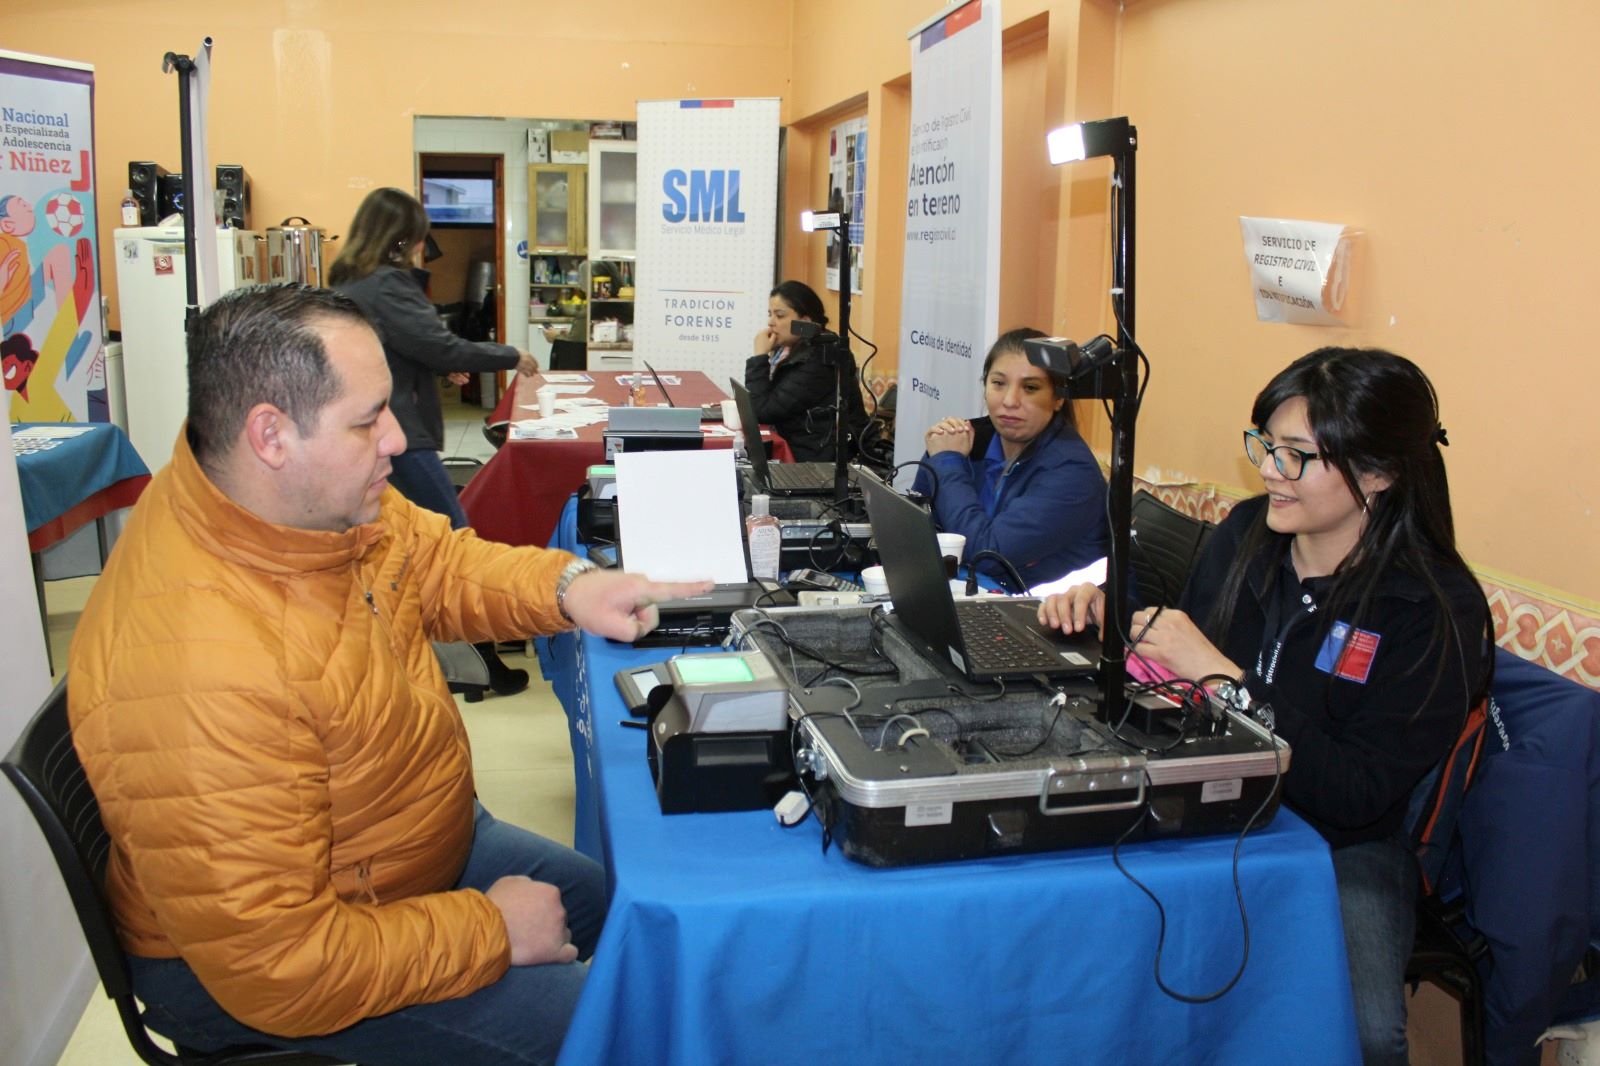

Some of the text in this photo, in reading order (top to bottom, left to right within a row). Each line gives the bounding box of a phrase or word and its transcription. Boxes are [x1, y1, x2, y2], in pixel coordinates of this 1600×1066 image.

[2, 107, 69, 127] Nacional
[5, 124, 70, 138] Especializada
[2, 137, 72, 151] Adolescencia
[9, 150, 72, 174] Niñez
[662, 168, 746, 223] SML
[908, 198, 919, 217] en
[660, 223, 692, 235] Servicio
[724, 224, 746, 237] Legal
[1261, 235, 1316, 251] SERVICIO DE
[1254, 253, 1316, 272] REGISTRO CIVIL
[1278, 275, 1283, 287] E
[664, 314, 733, 329] FORENSE
[679, 333, 720, 343] desde 1915
[936, 336, 945, 351] de
